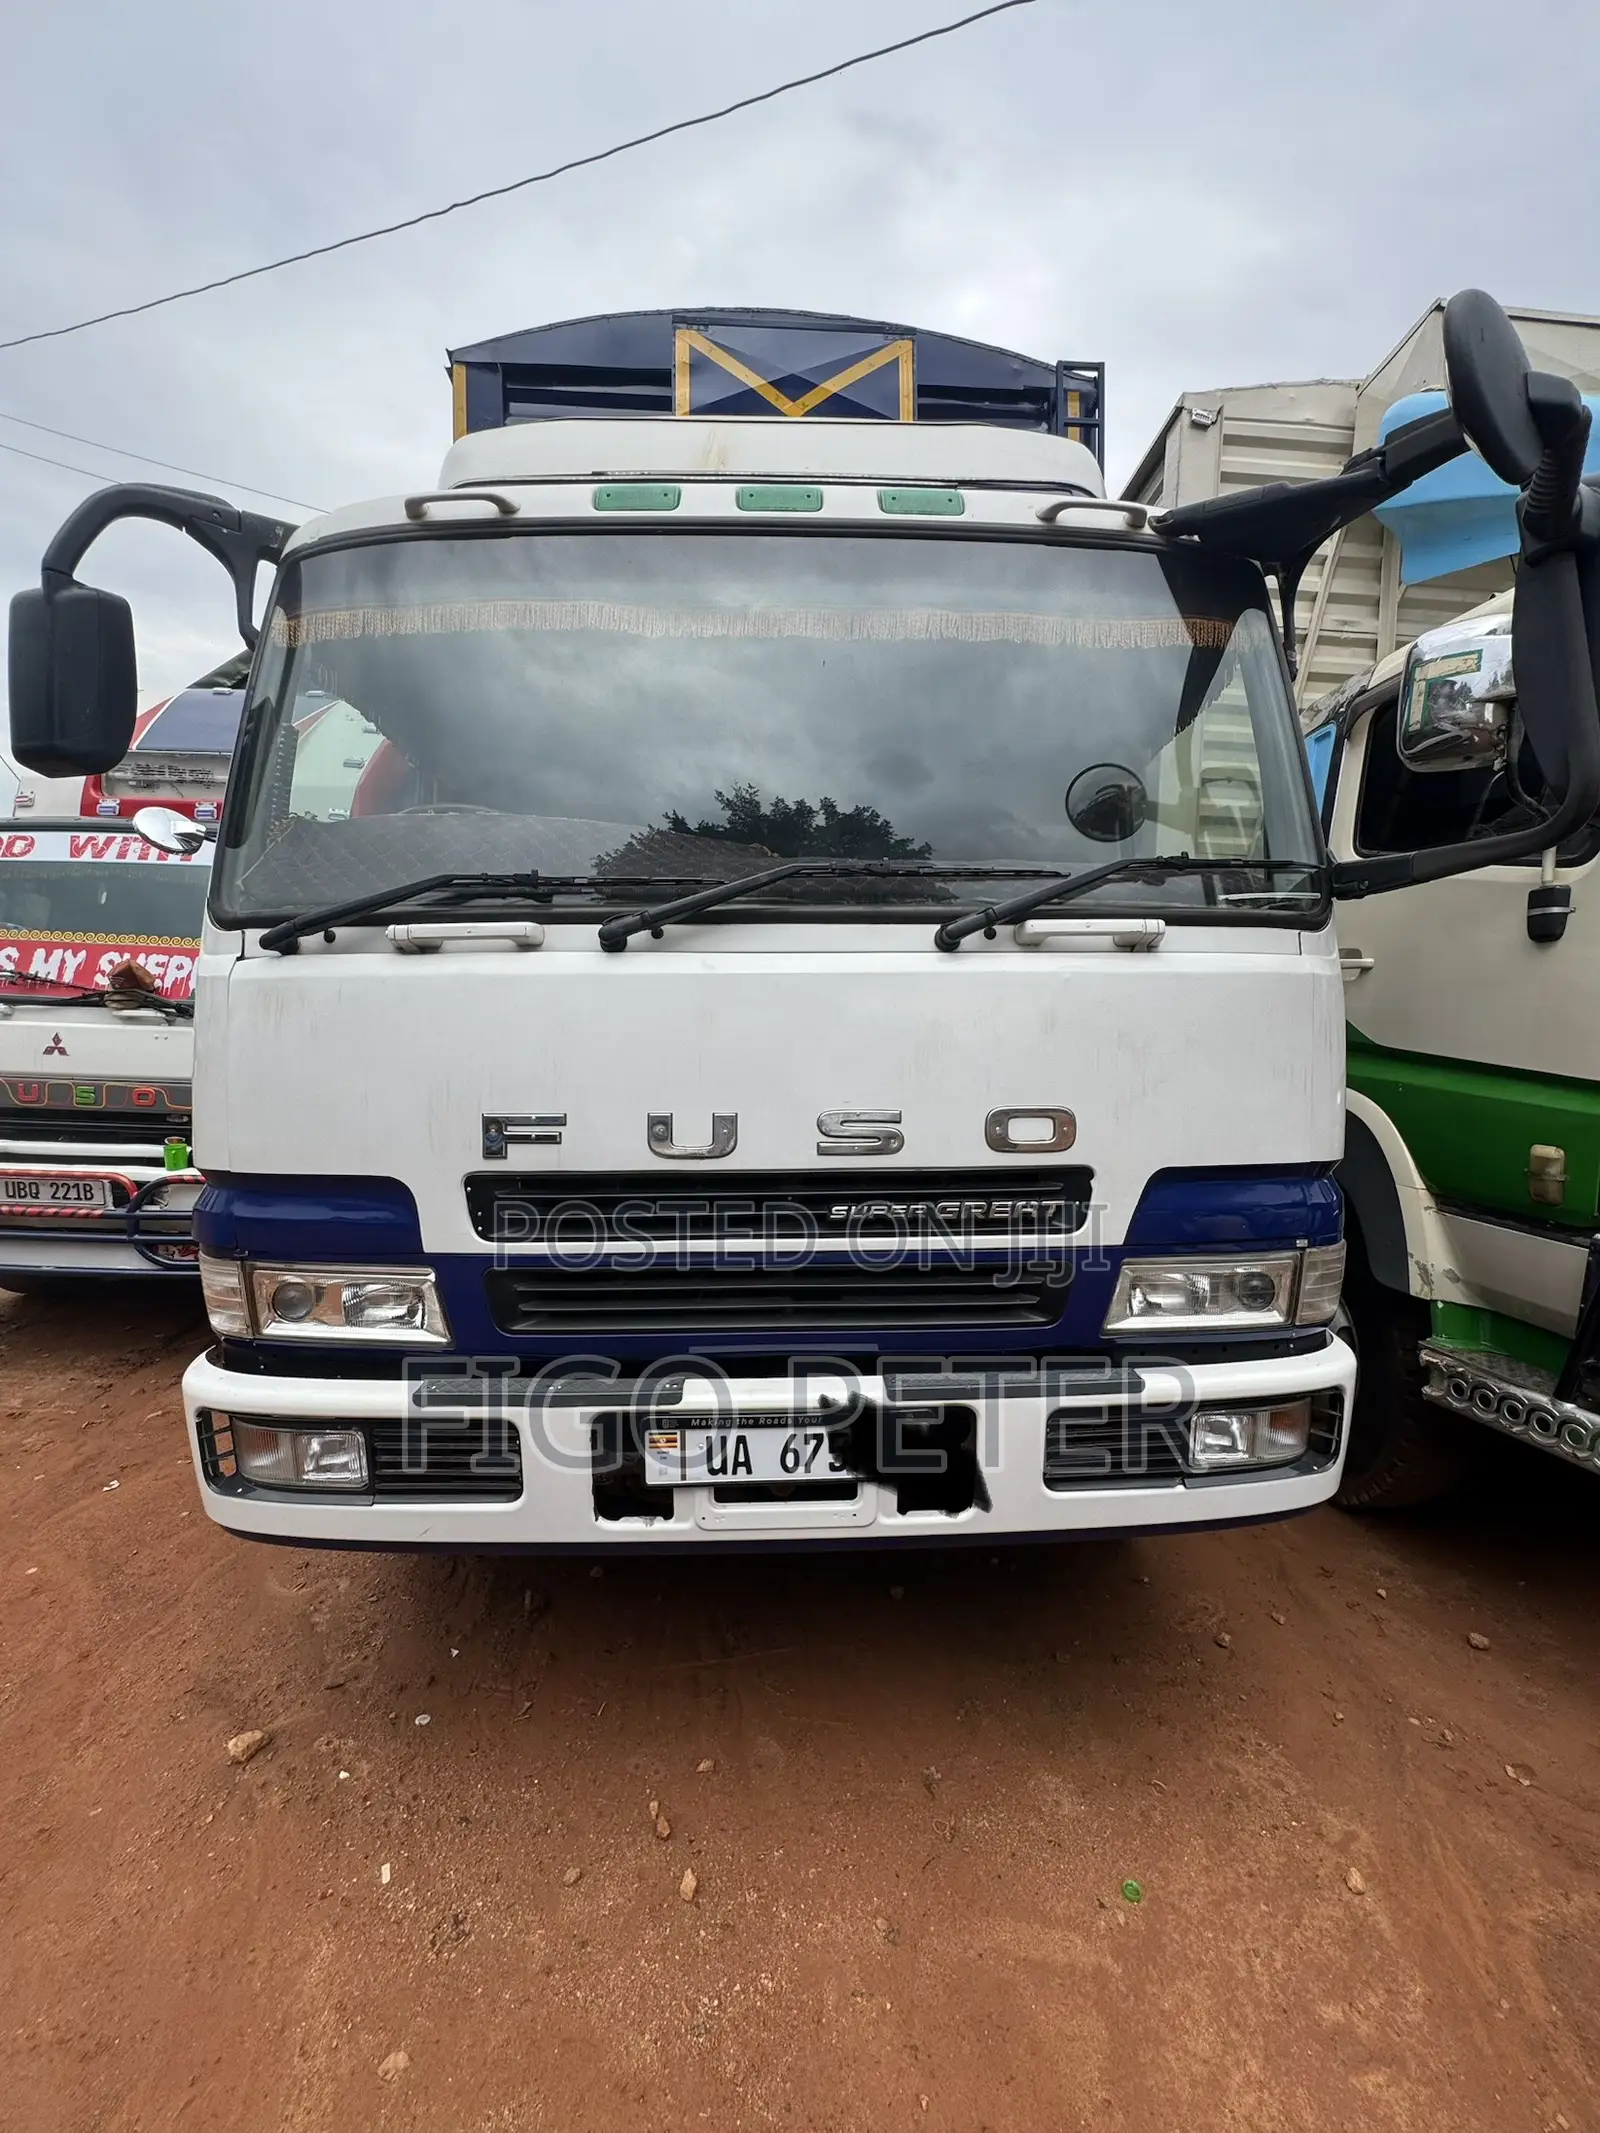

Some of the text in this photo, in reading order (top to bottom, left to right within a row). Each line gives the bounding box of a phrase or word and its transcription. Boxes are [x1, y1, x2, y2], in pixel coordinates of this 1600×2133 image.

[28, 948, 87, 985] MY
[482, 1105, 1077, 1159] FUSO
[5, 1181, 94, 1200] UBQ 221B
[829, 1200, 1068, 1220] SUPER GREAT
[690, 1418, 732, 1428] Making
[736, 1418, 755, 1426] the
[758, 1416, 793, 1425] Roads
[798, 1416, 822, 1424] Your
[706, 1434, 753, 1475] UA
